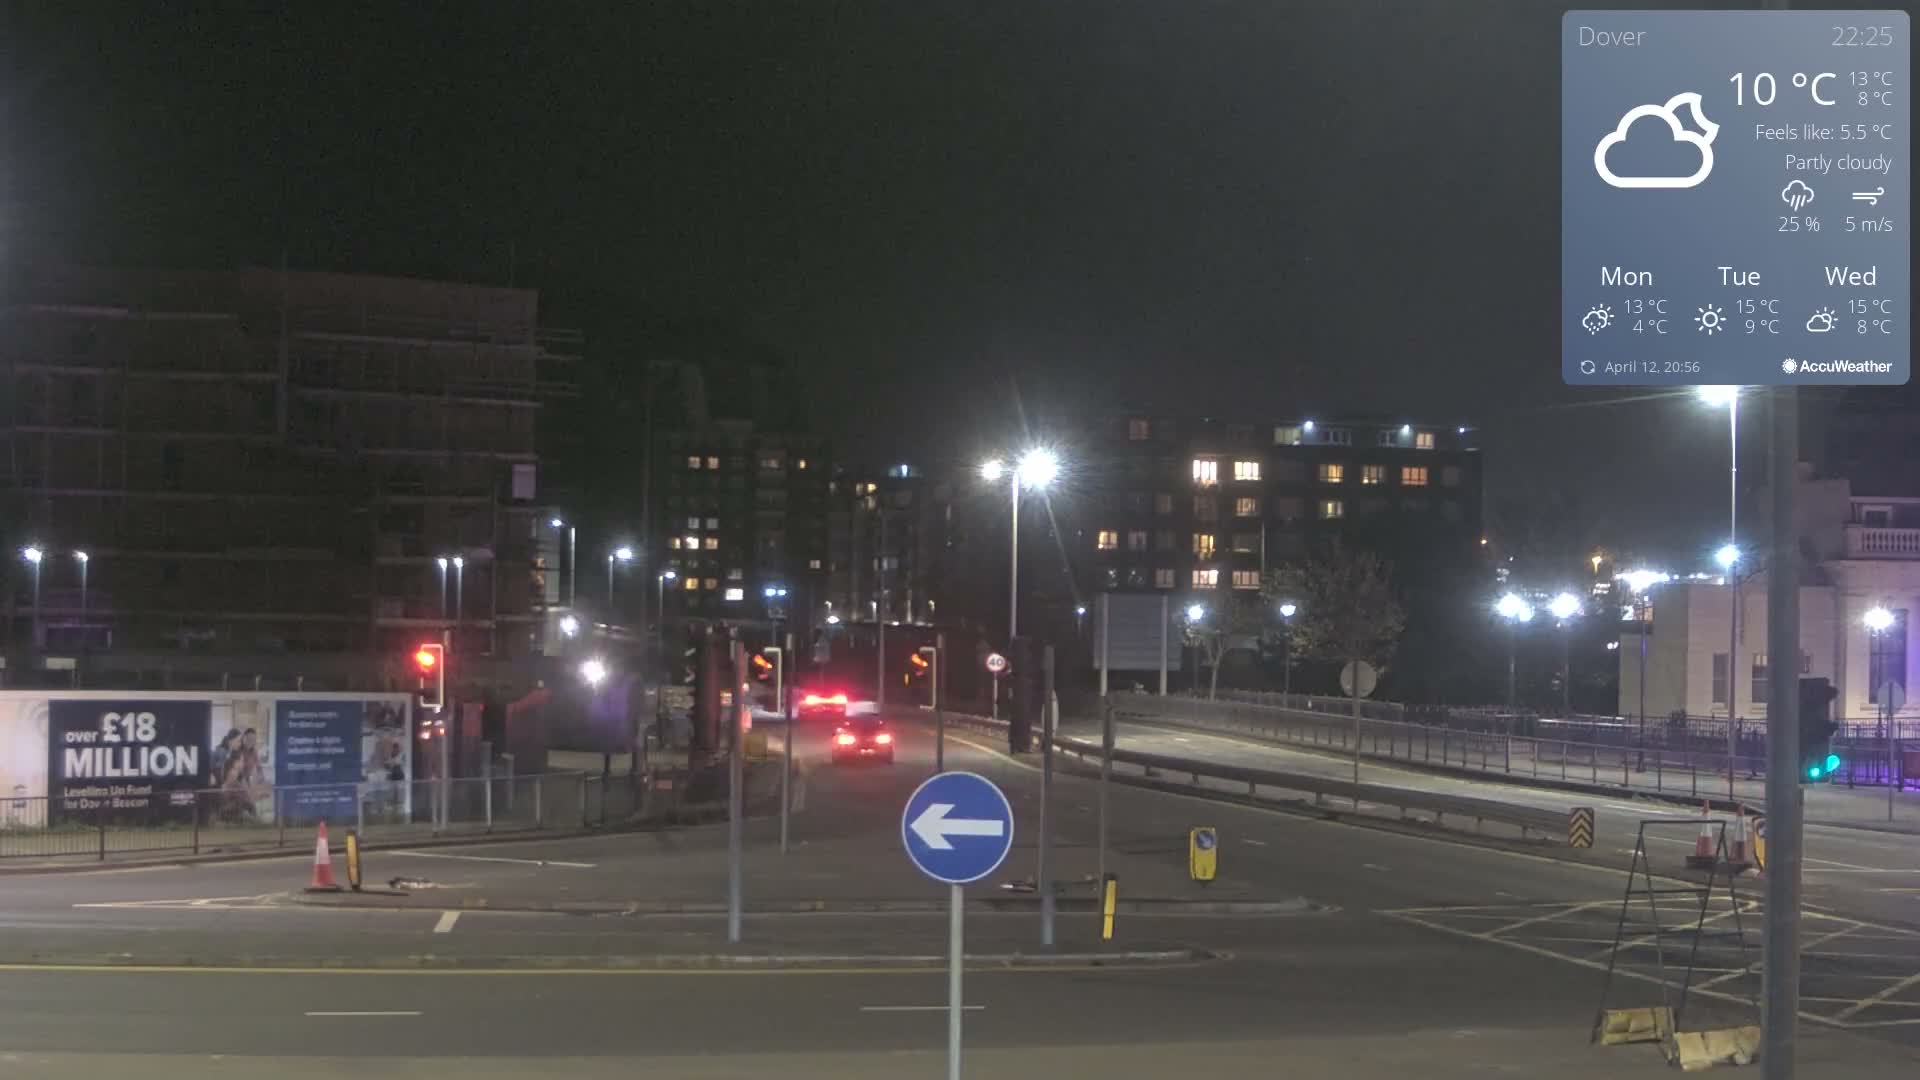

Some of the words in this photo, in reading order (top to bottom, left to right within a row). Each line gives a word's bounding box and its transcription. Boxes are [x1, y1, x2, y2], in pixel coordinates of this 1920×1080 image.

[988, 657, 1004, 667] 40
[65, 731, 98, 742] over
[102, 711, 156, 742] £18
[65, 745, 198, 777] MILLION
[127, 784, 153, 796] Fund
